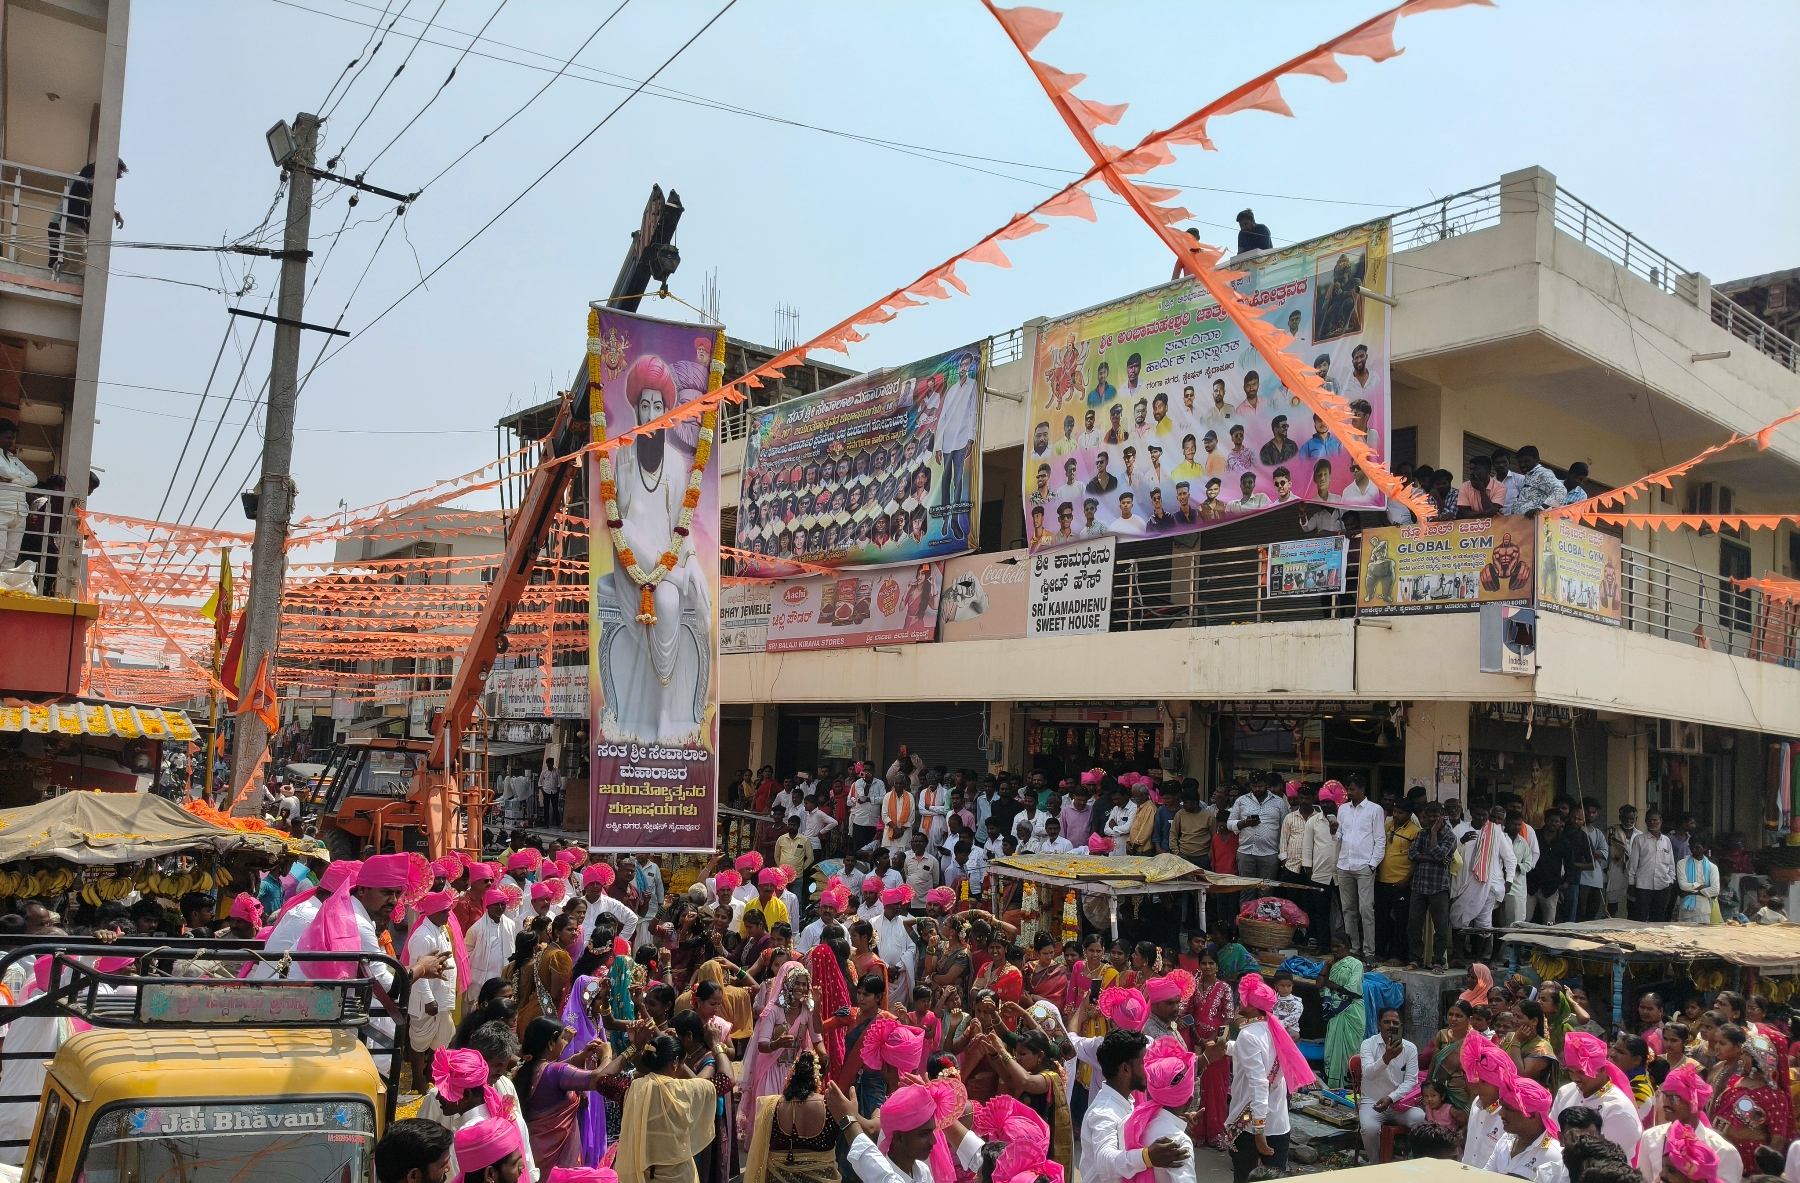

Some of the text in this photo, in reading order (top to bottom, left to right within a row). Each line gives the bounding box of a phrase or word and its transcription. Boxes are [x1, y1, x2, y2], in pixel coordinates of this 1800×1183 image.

[1099, 333, 1112, 355] ಶ್ರೀ
[1146, 340, 1240, 373] ಹಾರ್ದಿಕ ಸುಸ್ವಾಗತ
[1397, 536, 1494, 554] GLOBAL GYM
[1558, 540, 1604, 563] GLOBAL GYM
[1034, 555, 1049, 577] ಶ್ರೀ
[1054, 545, 1110, 569] ಕಾಮಧೇನು
[784, 589, 806, 600] Aachi
[1040, 569, 1101, 601] ಸ್ವೀಟ್ ಹೌಸ್
[741, 603, 771, 618] JEWELLE
[1032, 597, 1107, 617] SRI KAMADHENU
[772, 613, 785, 631] ಚಿಲ್ಲಿ
[787, 610, 813, 624] ಪೌಡರ್
[1036, 614, 1100, 632] SWEET HOUSE
[798, 640, 820, 648] KIRANA
[821, 638, 844, 646] STORES
[597, 743, 708, 763] ಸಂತ ಶ್ರೀ ಸೇವಾಲಾಲ
[620, 764, 688, 780] ಮಹಾರಾಜರ
[608, 802, 698, 817] ಶುಭಾಷಯಗಳು
[161, 1108, 325, 1133] Jai Bhavani
